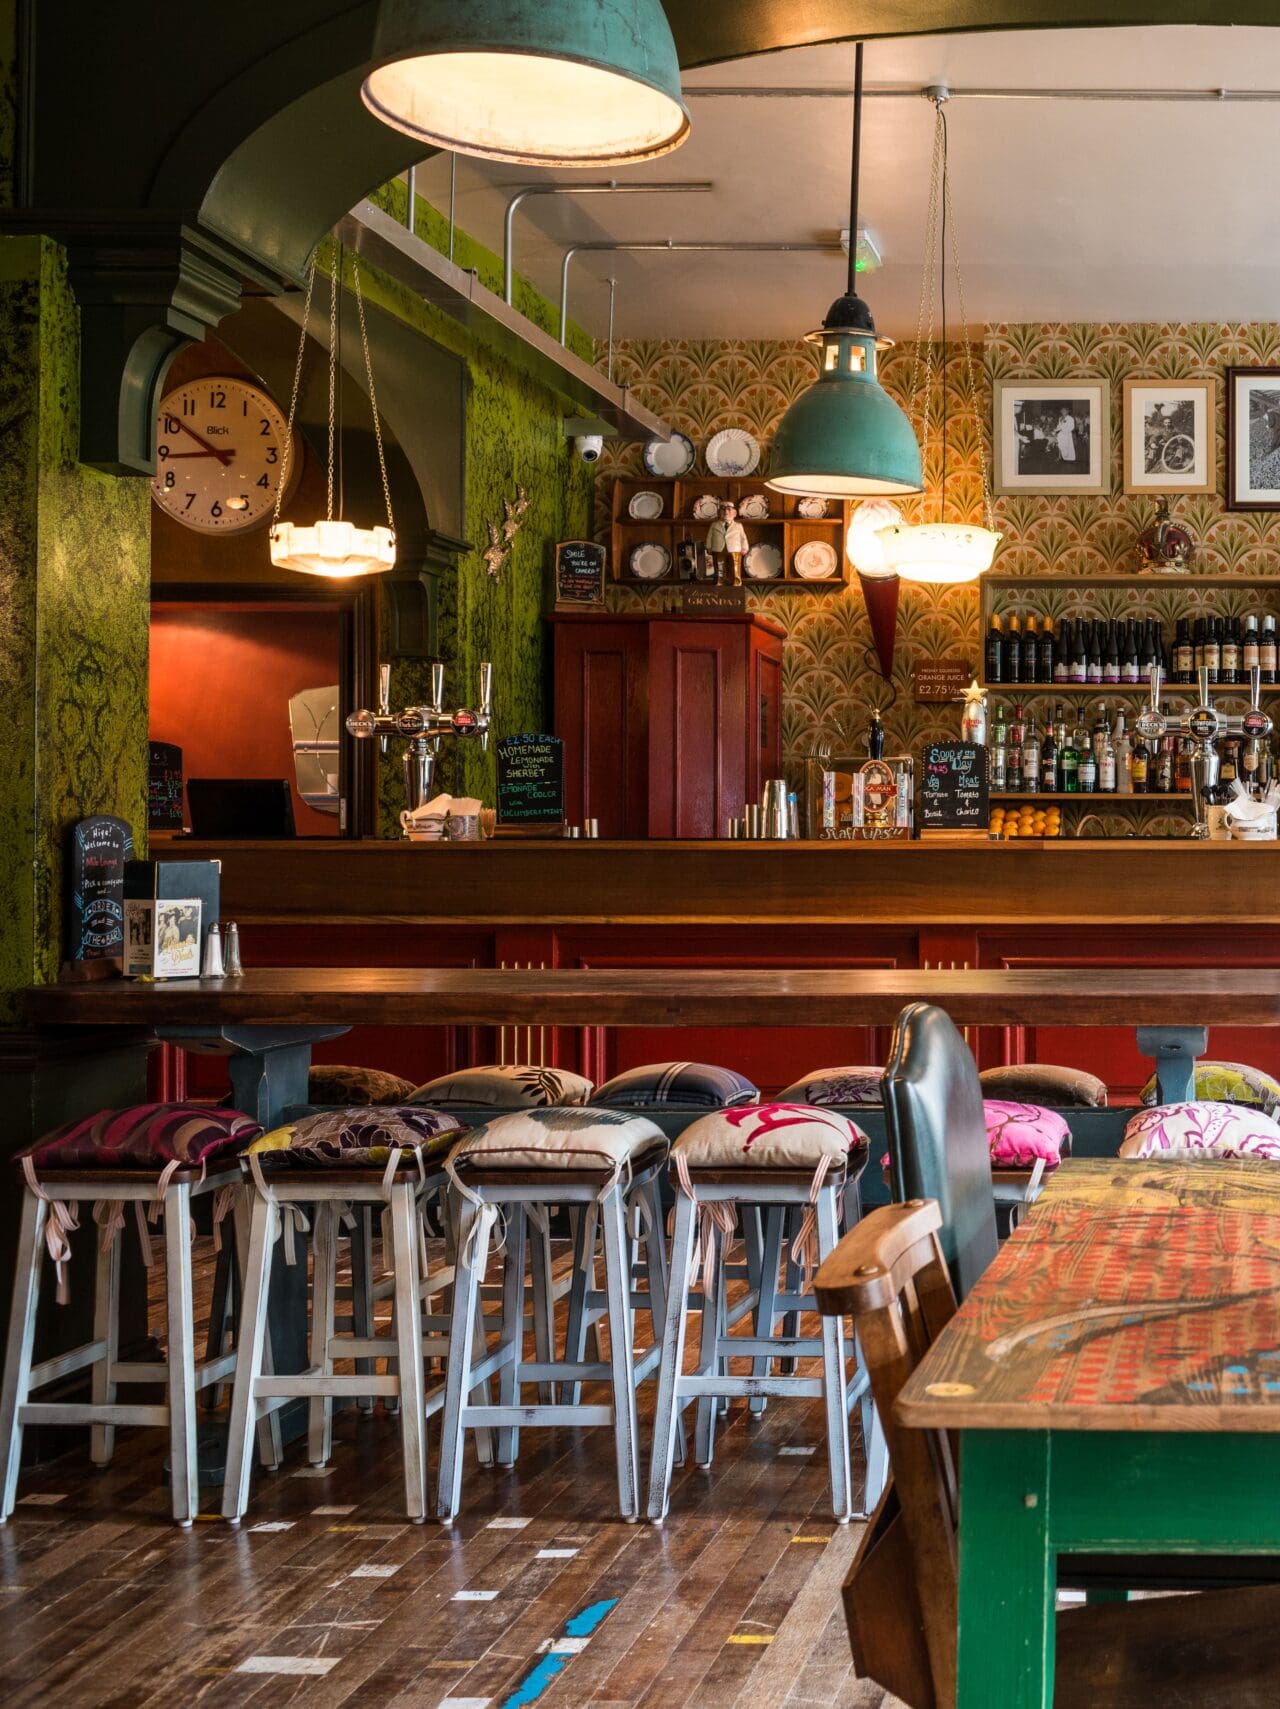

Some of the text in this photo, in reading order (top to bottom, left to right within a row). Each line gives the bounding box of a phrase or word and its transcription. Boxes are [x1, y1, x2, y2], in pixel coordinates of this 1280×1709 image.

[210, 392, 226, 408] 12
[184, 400, 195, 416] 11
[243, 401, 247, 416] 1
[164, 417, 181, 434] 10
[207, 426, 229, 435] Blick
[260, 420, 271, 436] 2
[158, 445, 170, 462] 9
[266, 448, 278, 464] 3
[165, 471, 176, 488] 8
[256, 473, 270, 489] 4
[186, 494, 196, 510] 7
[211, 501, 222, 517] 6
[539, 734, 561, 745] EACH
[498, 745, 551, 759] HOMEMADE
[930, 748, 955, 763] Soup
[510, 756, 554, 764] LEMONADE
[951, 758, 972, 774] Day
[506, 768, 546, 778] SHERBET
[959, 774, 979, 788] Meat
[498, 784, 538, 795] LEMONADE
[527, 790, 557, 799] COOLER
[954, 789, 980, 799] Tomato
[820, 827, 857, 840] Staff
[84, 840, 119, 851] Welcome to
[84, 879, 96, 888] Pick
[92, 902, 116, 913] ORDER
[89, 931, 118, 945] THE BAR
